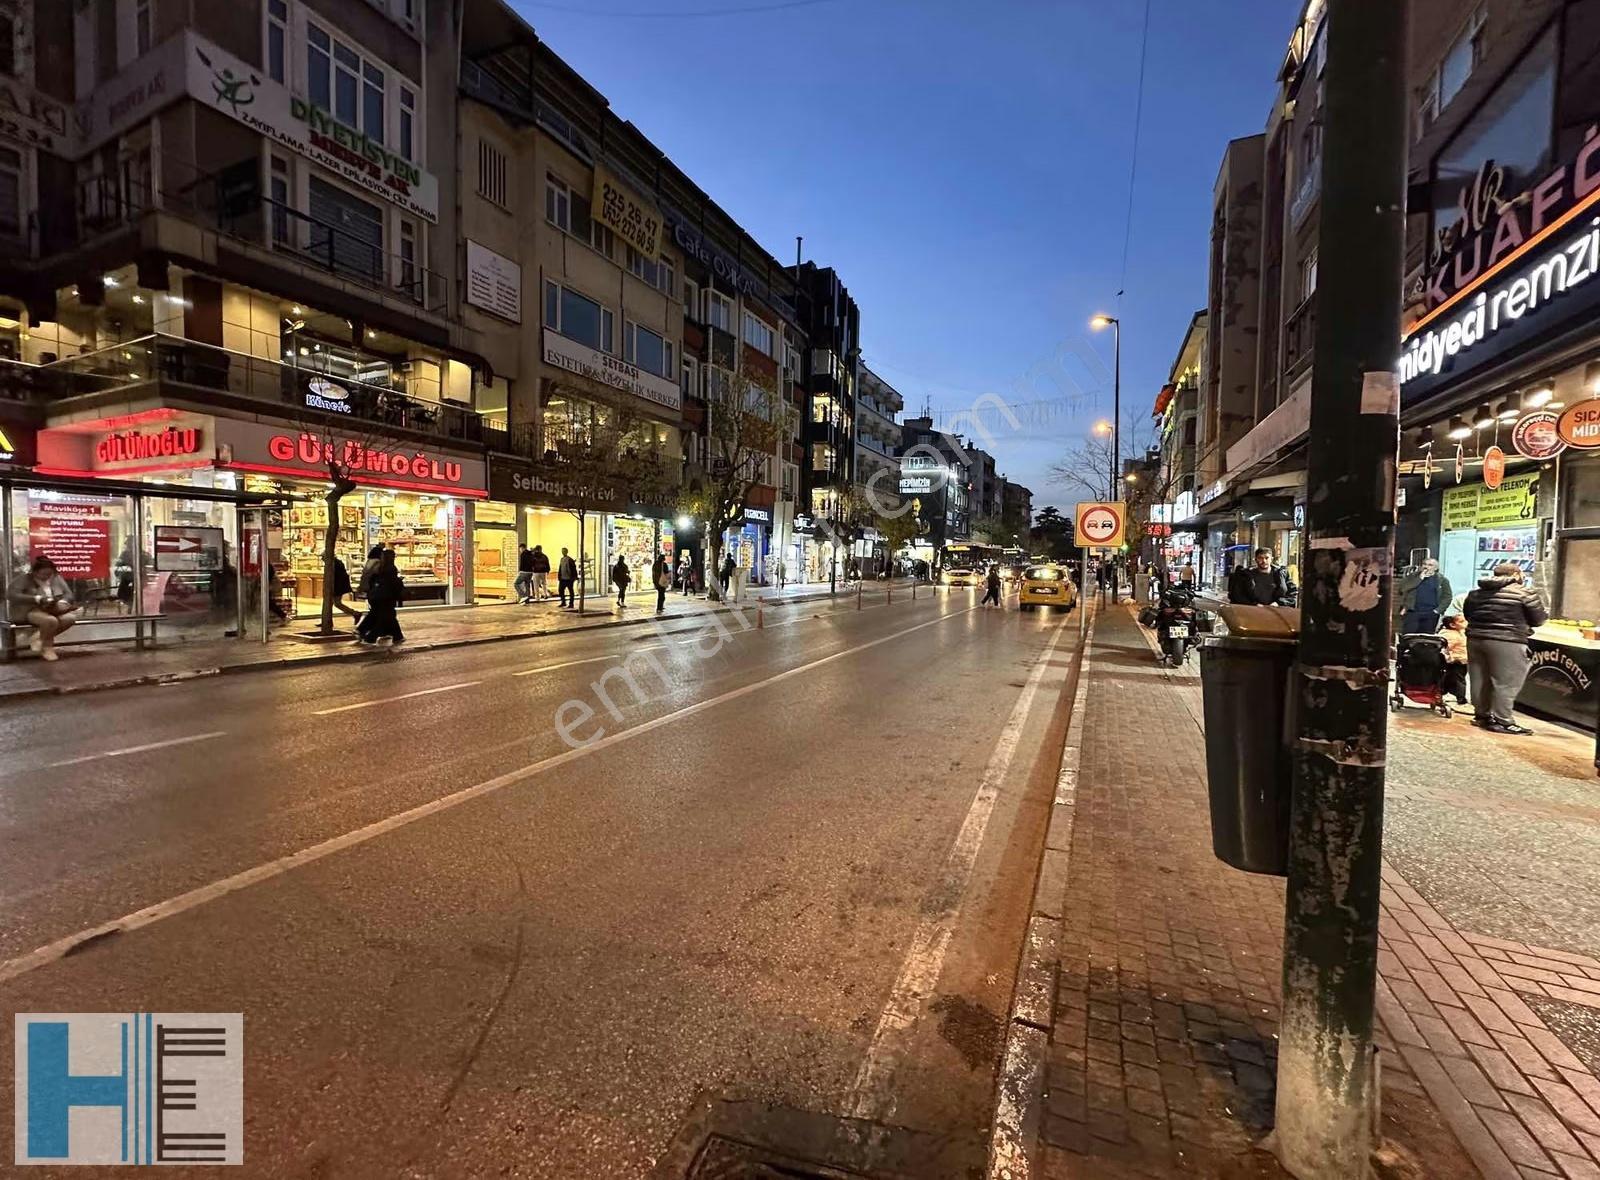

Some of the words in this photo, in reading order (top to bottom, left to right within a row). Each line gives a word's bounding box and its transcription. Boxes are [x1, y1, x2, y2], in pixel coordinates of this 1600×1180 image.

[603, 182, 625, 213] 225
[628, 201, 641, 226] 26
[645, 217, 657, 237] 47
[1490, 216, 1600, 331] remzi
[268, 433, 463, 482] GÜLÜMOĞLU
[512, 472, 565, 497] Setbaşı
[1500, 478, 1530, 491] TELEKOM
[453, 505, 465, 588] BAKLAVA
[1531, 648, 1559, 665] dyeci
